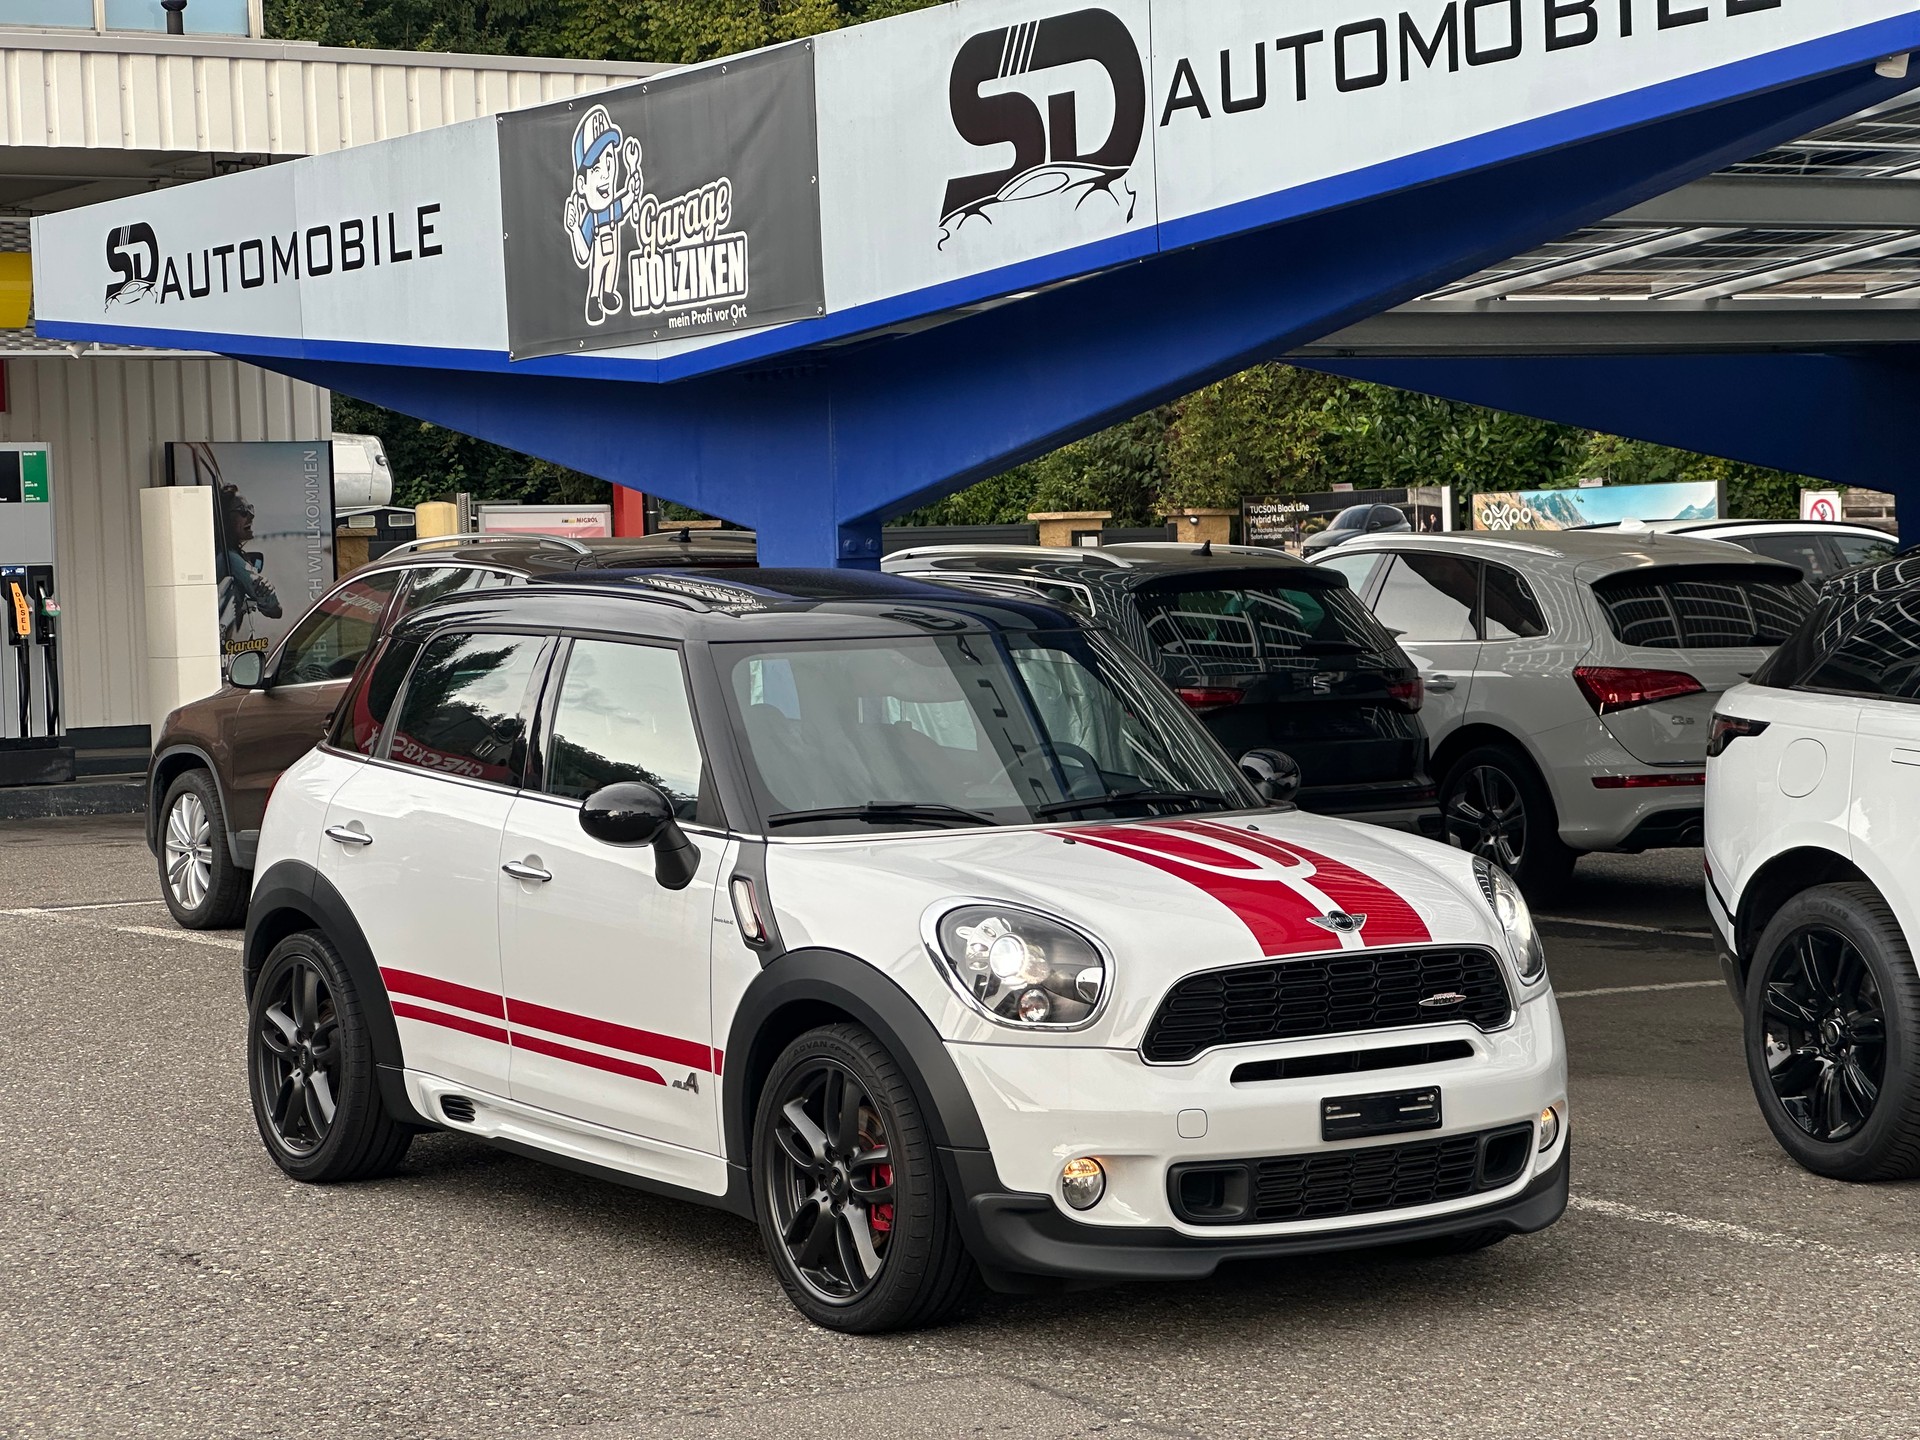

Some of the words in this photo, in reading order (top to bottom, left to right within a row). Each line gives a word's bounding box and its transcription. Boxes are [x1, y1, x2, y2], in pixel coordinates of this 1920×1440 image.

[1159, 0, 1782, 127] AUTOMOBIL
[639, 183, 729, 257] Garage
[160, 203, 443, 304] AUTOMOBILE
[631, 239, 746, 309] HOLZIKEN
[668, 311, 690, 328] mein
[691, 306, 713, 326] Profi
[714, 309, 729, 321] vor
[730, 304, 747, 320] Ort
[304, 450, 323, 574] WILLKOMMEN
[1250, 505, 1277, 513] TUCSON
[1278, 504, 1295, 512] Black
[1296, 503, 1309, 511] Line
[1250, 514, 1272, 525] Hybrid
[15, 592, 27, 631] DIESEL
[225, 637, 268, 655] Garage
[793, 1040, 828, 1057] ADVAN
